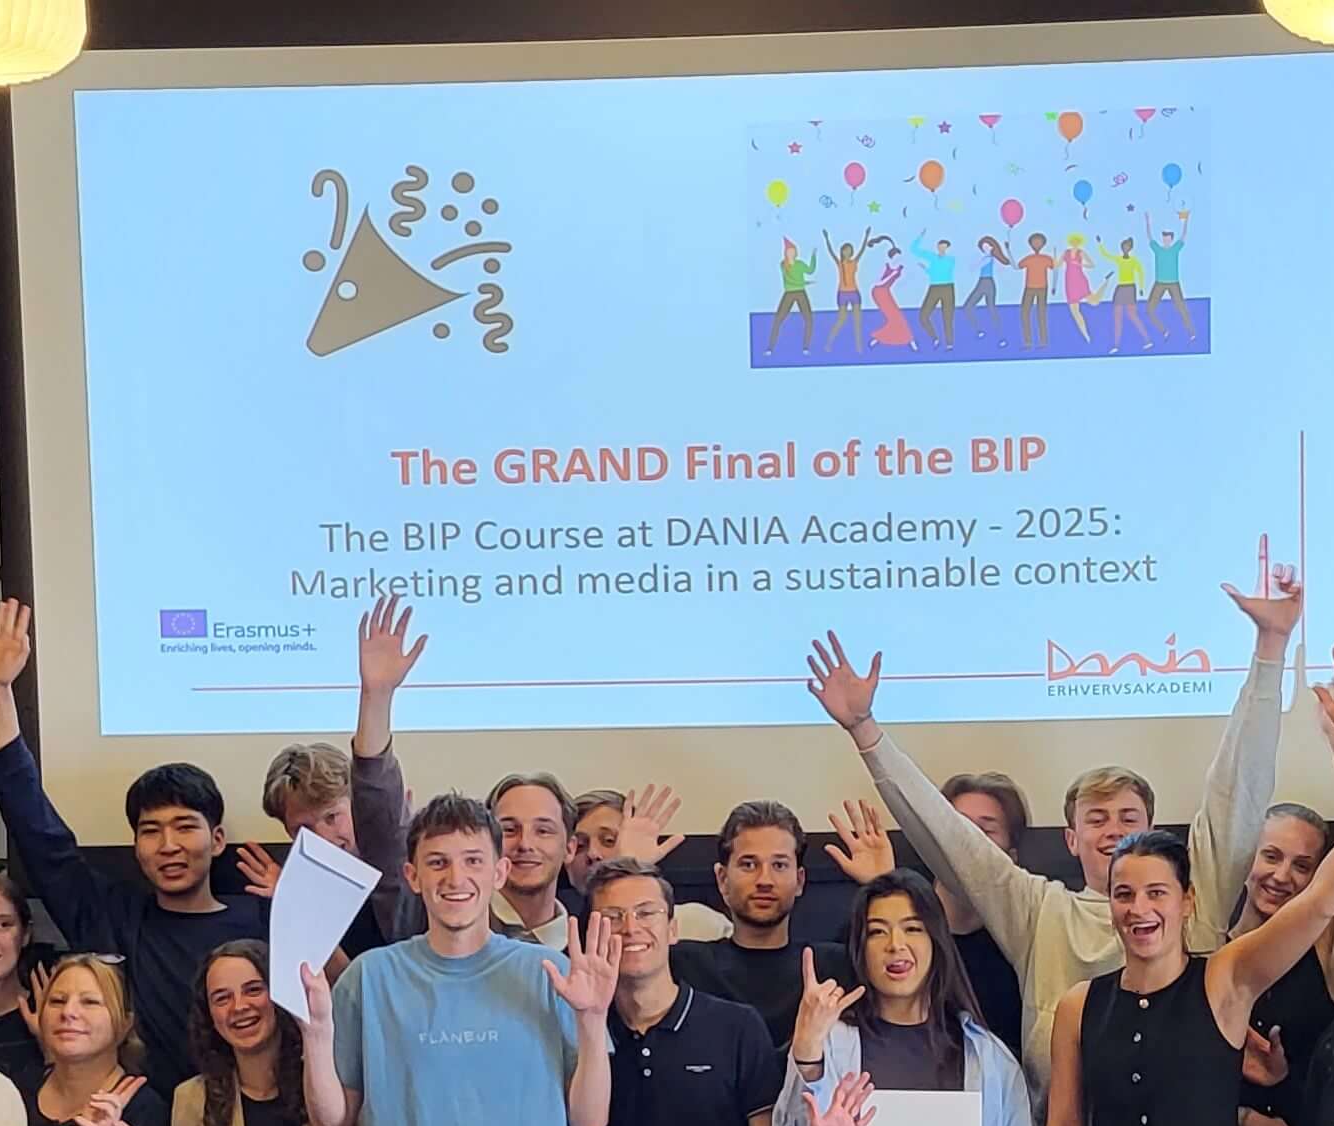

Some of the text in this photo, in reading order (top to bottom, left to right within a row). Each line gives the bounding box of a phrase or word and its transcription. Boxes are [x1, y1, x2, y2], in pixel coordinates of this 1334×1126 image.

[390, 436, 1046, 485] The GRAND Final of the BIP
[319, 521, 389, 552] The
[403, 521, 461, 551] BIP
[474, 520, 604, 550] Course
[617, 520, 653, 549] at
[666, 515, 789, 546] DANIA
[801, 511, 977, 548] Academy
[1015, 506, 1121, 538] 2025:
[290, 554, 1158, 603] Marketing and media in a sustainable context
[212, 622, 316, 639] Erasmus+
[238, 642, 281, 653] opening
[1047, 680, 1212, 697] ERHVERVSAKADEMI
